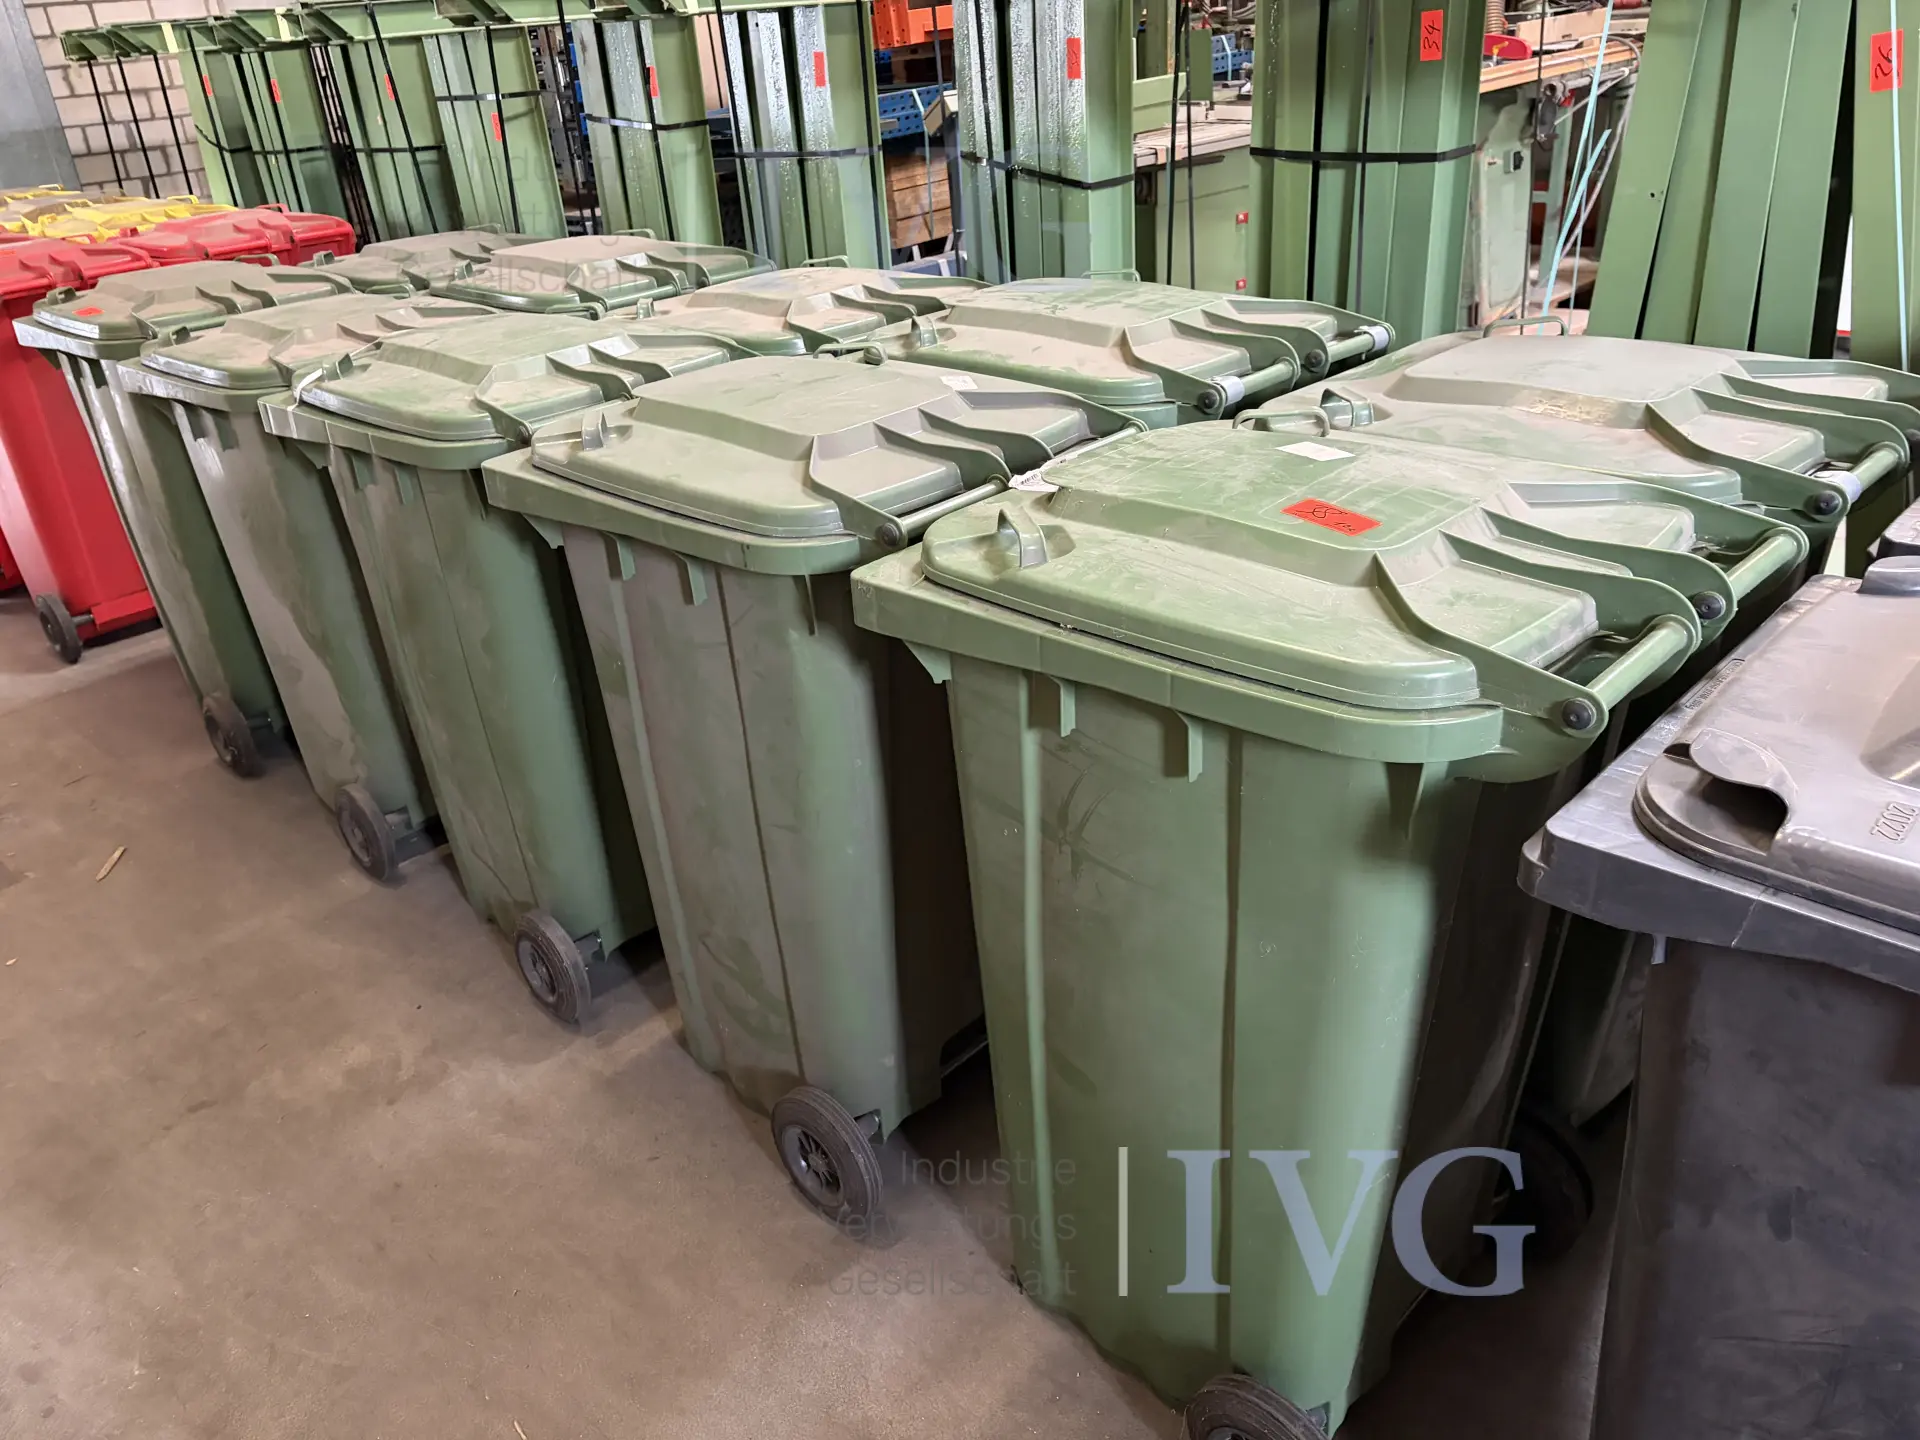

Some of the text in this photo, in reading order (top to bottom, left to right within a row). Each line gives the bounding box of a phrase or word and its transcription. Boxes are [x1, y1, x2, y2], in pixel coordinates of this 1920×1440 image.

[1423, 19, 1441, 53] 34
[1874, 45, 1900, 80] 26
[1869, 802, 1919, 843] 2022
